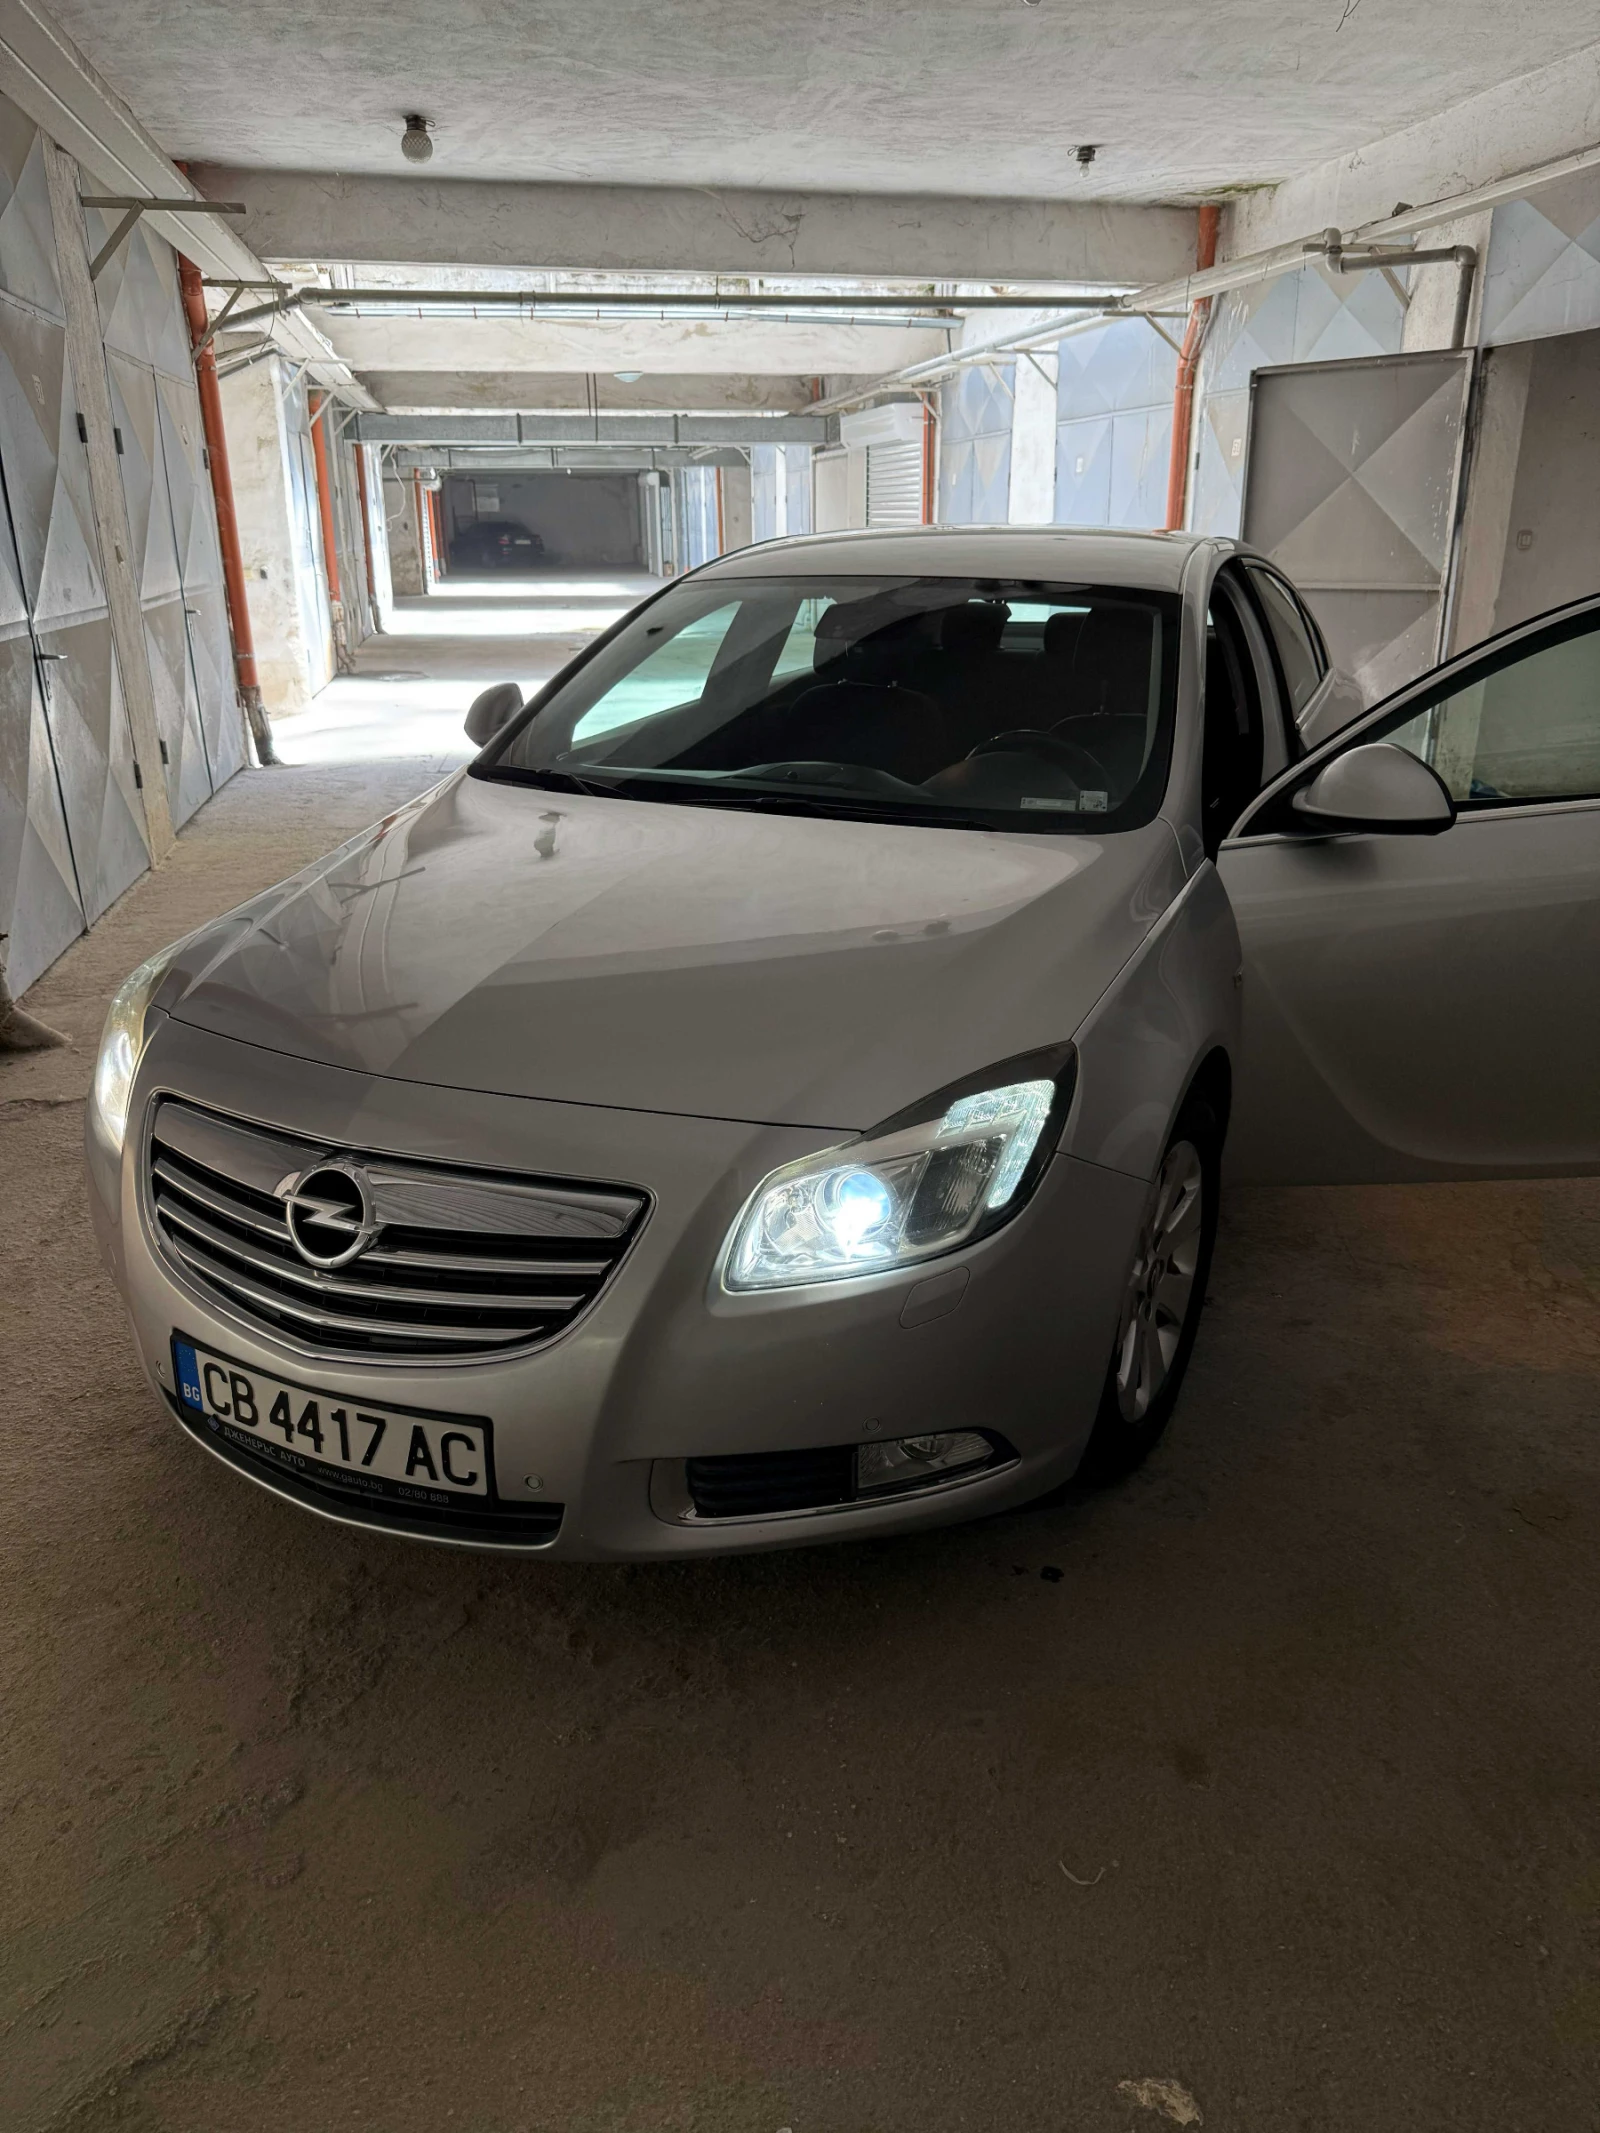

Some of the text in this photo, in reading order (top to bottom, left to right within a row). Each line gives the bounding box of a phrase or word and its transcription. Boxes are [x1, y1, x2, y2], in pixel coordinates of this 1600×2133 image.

[183, 1382, 200, 1401] BG
[203, 1362, 478, 1487] CB 4417 AC
[280, 1451, 305, 1467] АУТО
[318, 1467, 383, 1493] www.gauto.bg
